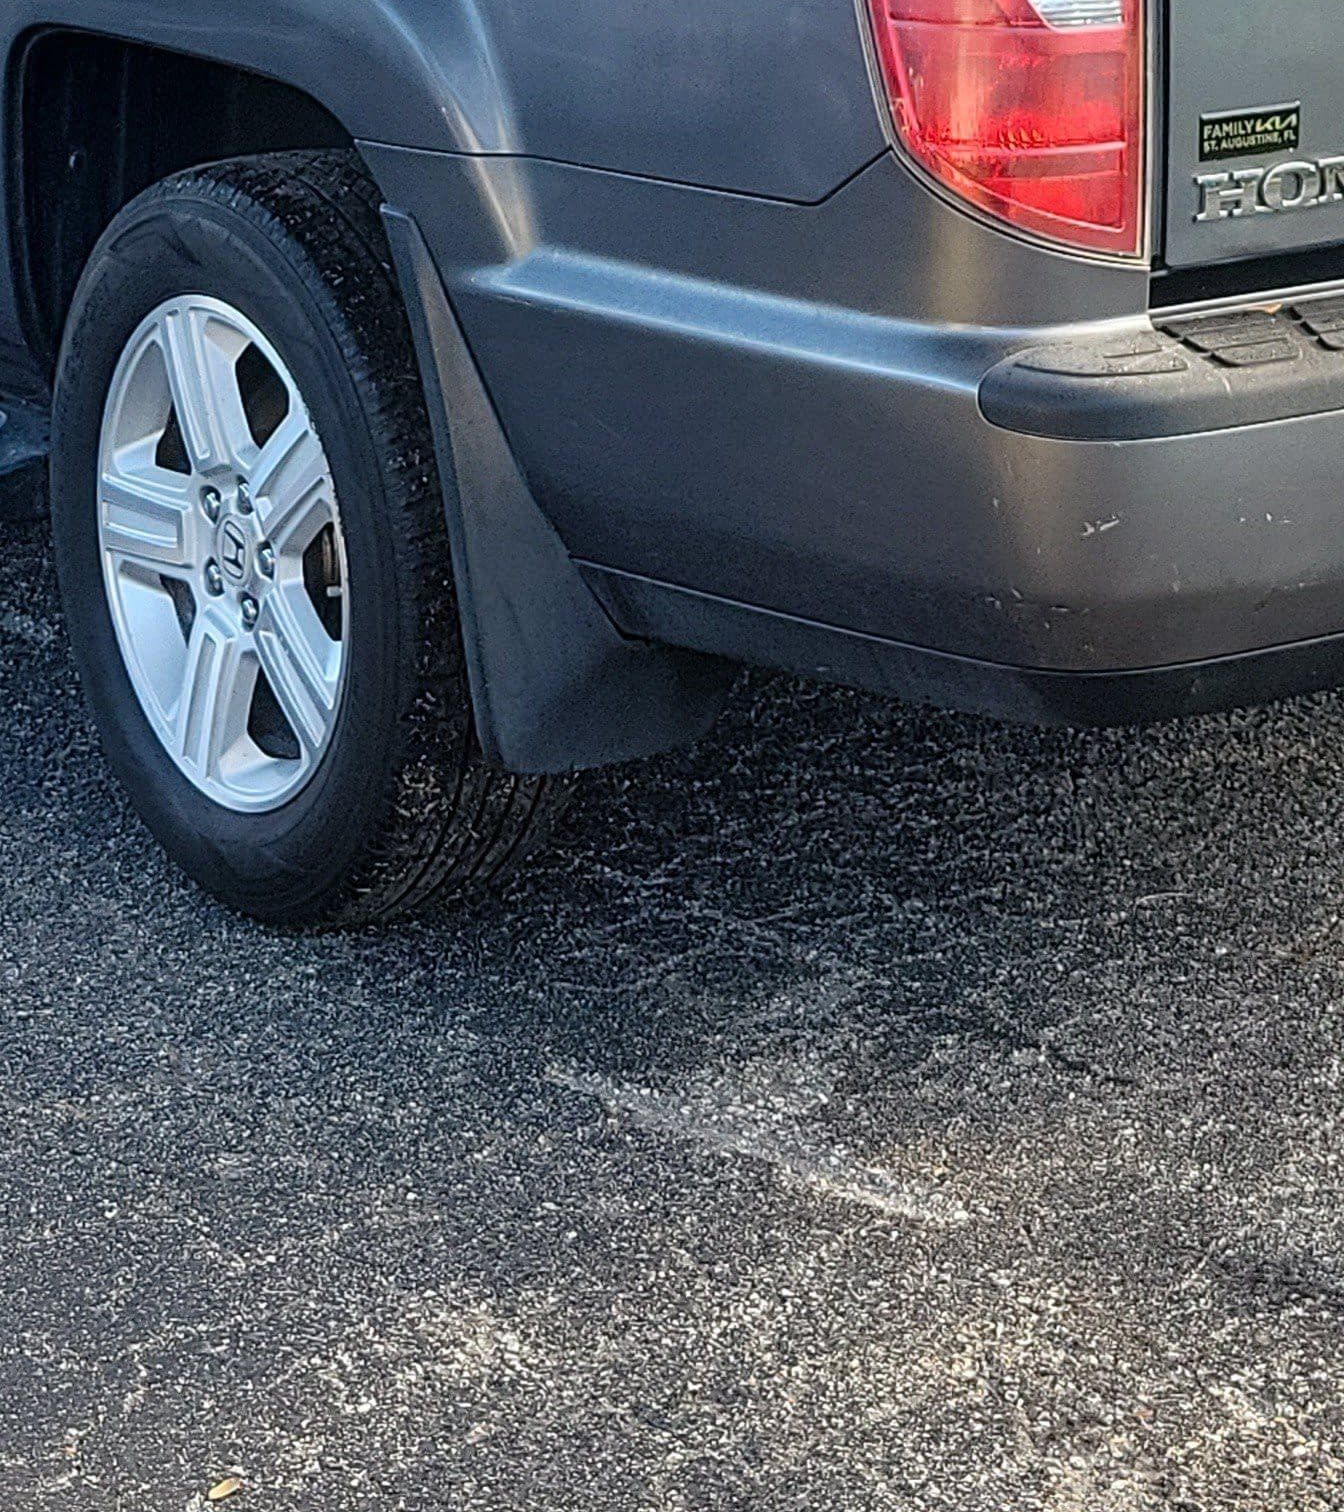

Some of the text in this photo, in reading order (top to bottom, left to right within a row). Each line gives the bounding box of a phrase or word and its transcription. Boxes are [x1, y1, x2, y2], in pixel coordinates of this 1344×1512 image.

[1203, 118, 1255, 140] FAMILY
[1203, 129, 1297, 154] ST. AUGUSTINE, FL
